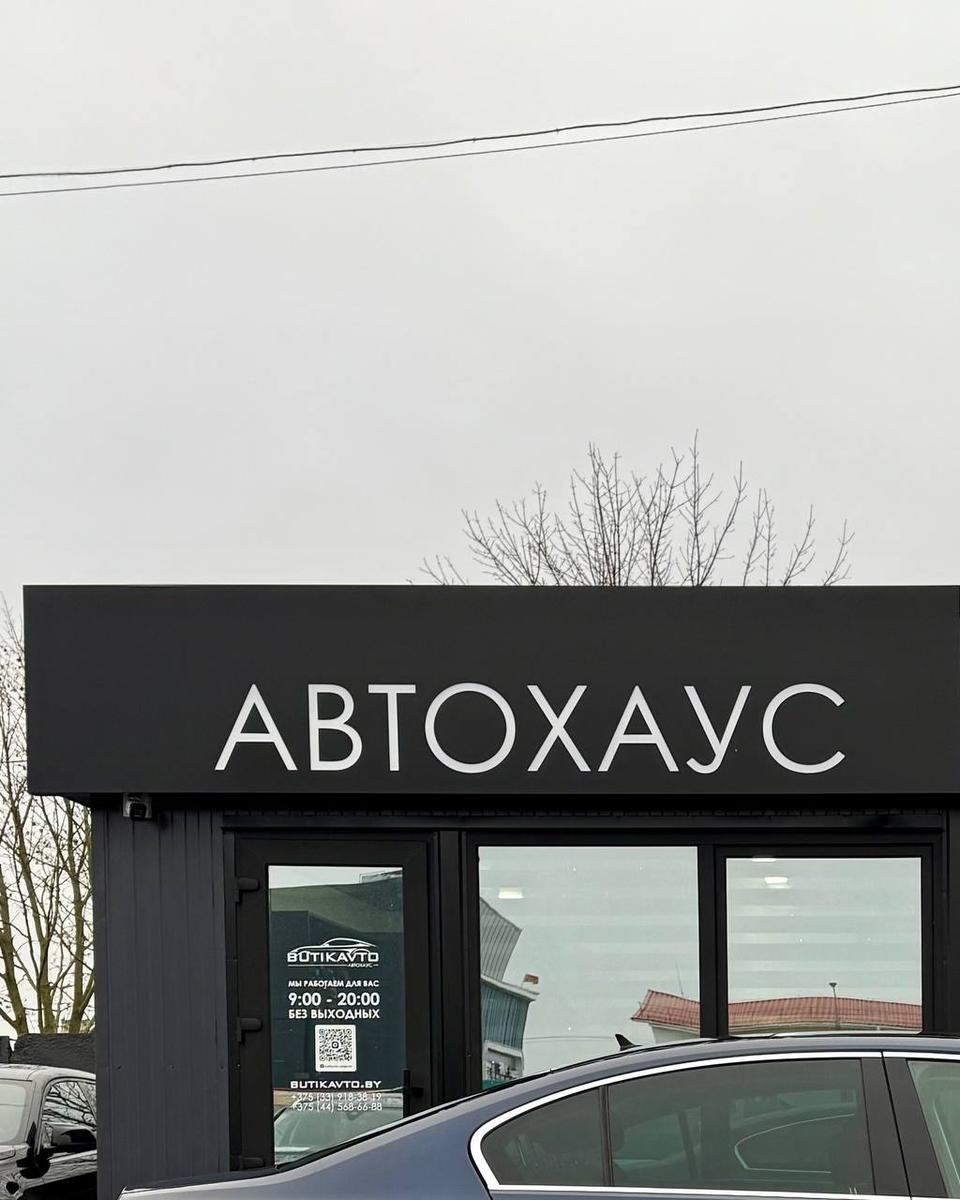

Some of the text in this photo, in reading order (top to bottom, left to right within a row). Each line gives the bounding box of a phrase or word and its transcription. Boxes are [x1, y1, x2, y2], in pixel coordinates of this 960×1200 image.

[214, 682, 846, 774] АВТОХАУС
[287, 952, 379, 963] BUTIKAVTO
[303, 980, 344, 988] РАБОТАЕМ
[345, 980, 362, 988] ДЛЯ
[288, 992, 322, 1006] 9:00
[337, 992, 380, 1006] 20:00
[288, 1008, 380, 1020] БЕЗ ВЫХОДНЫХ
[290, 1080, 382, 1089] BUTIKAVTO.BY
[291, 1092, 382, 1102] +375 (33) 918-3819
[316, 1102, 335, 1113] (44)
[336, 1102, 383, 1112] 568-66-88
